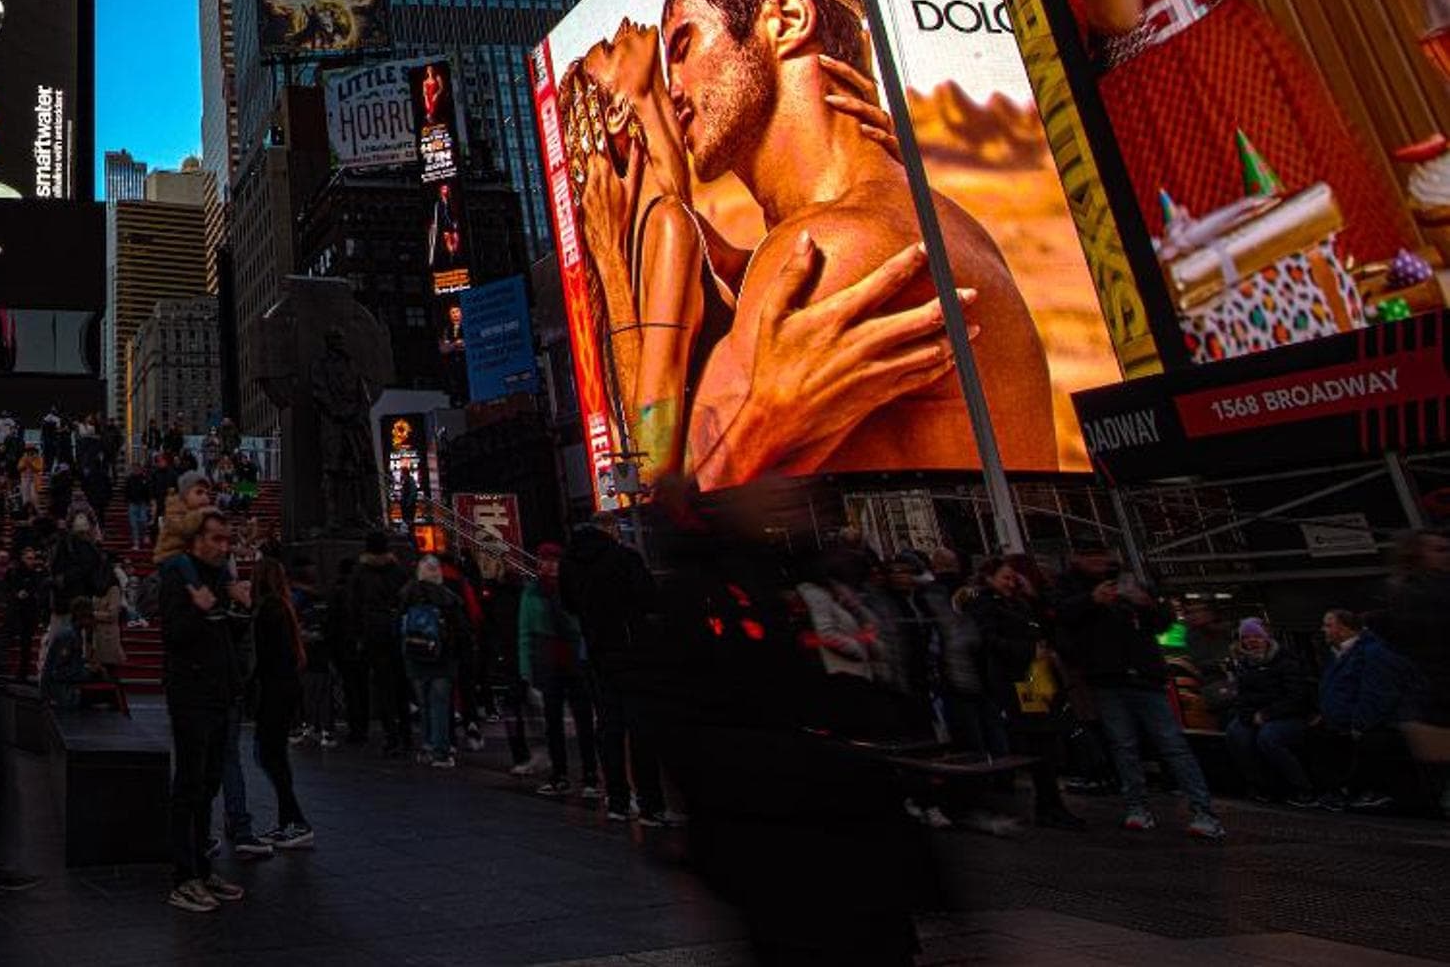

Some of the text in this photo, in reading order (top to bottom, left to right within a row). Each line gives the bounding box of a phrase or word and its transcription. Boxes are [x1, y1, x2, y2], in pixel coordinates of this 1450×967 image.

[337, 65, 398, 103] LITTLE
[34, 84, 53, 198] smartwater
[339, 97, 416, 156] HORRO
[1210, 367, 1400, 421] 1568 BROADWAY
